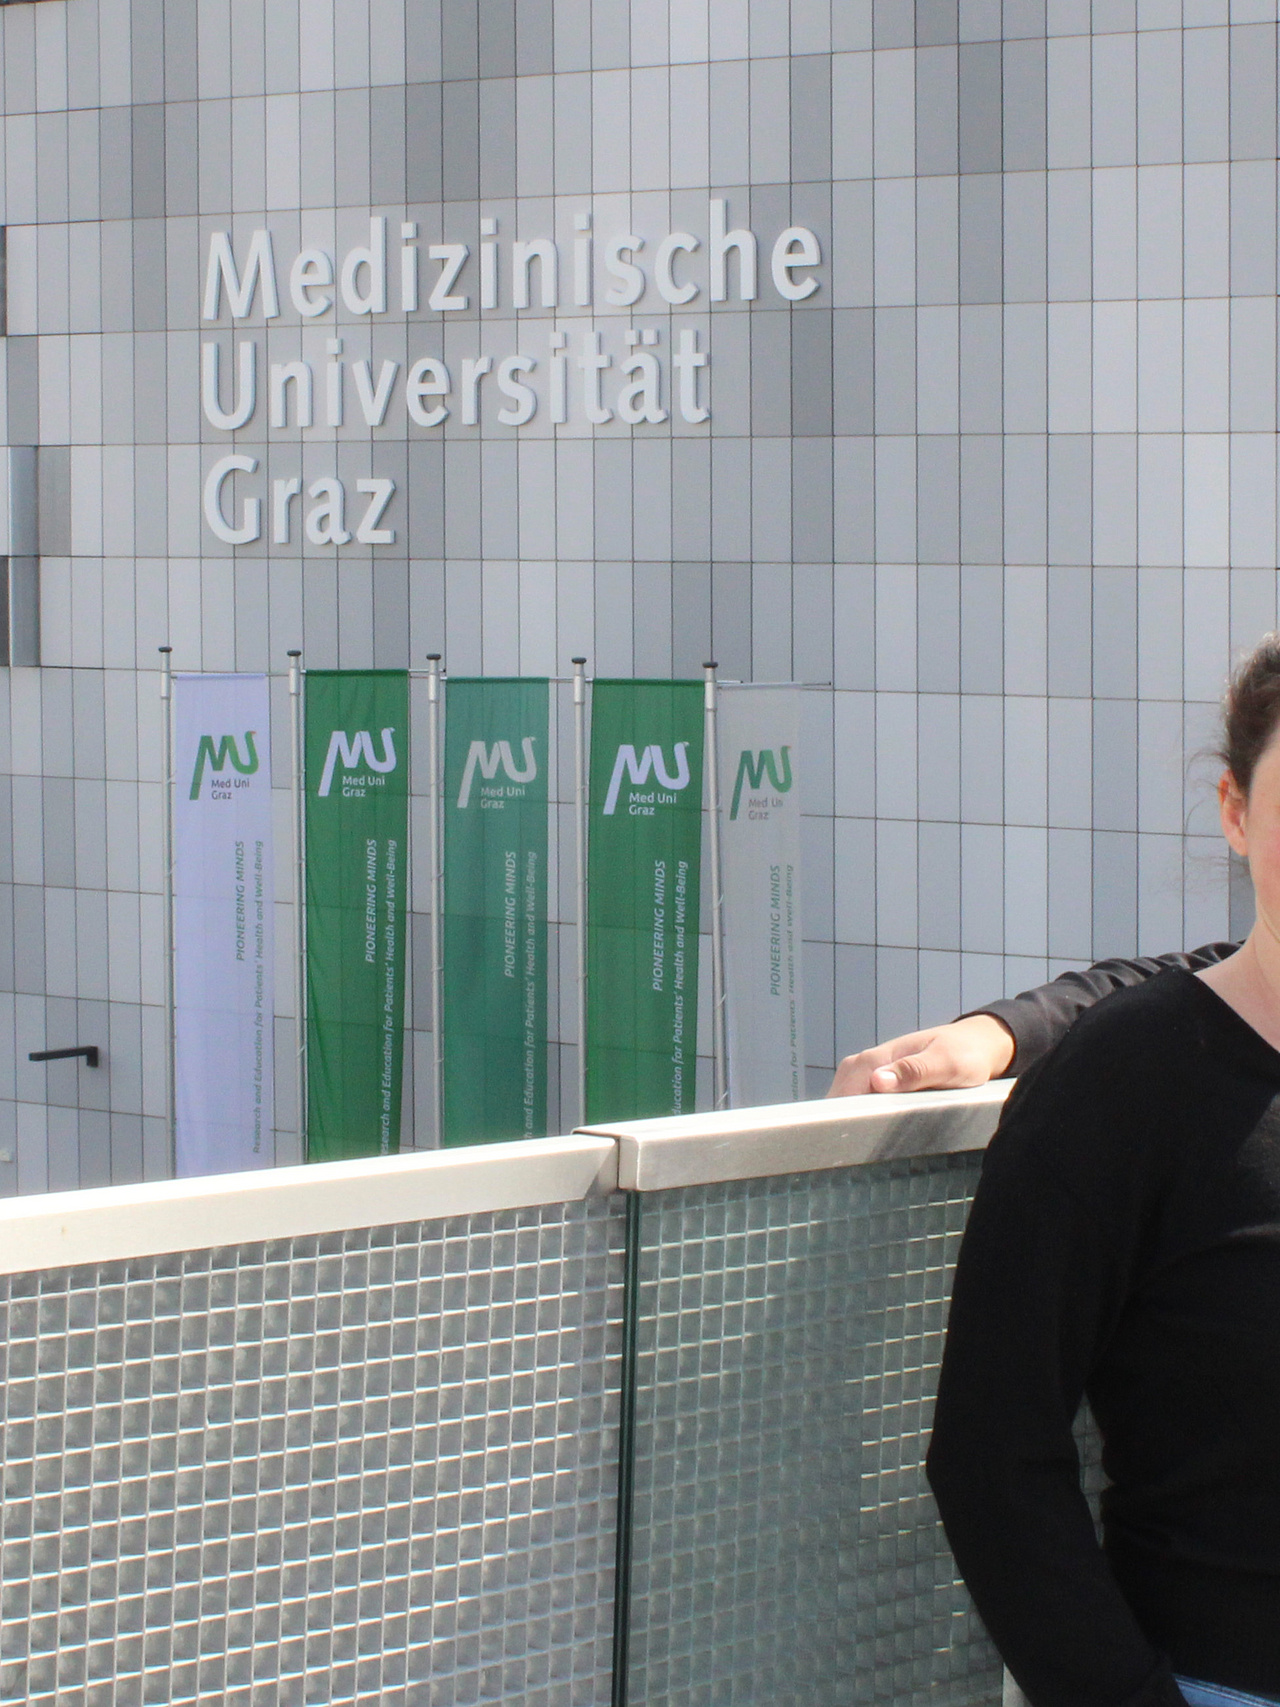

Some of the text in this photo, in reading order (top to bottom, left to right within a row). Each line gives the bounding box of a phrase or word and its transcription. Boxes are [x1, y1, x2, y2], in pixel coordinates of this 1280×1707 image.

[203, 199, 820, 321] Medizinische
[202, 329, 711, 431] Universität
[203, 454, 397, 545] Graz
[211, 779, 250, 788] Med Uni
[211, 790, 232, 800] Graz
[342, 775, 385, 785] Med Uni
[342, 787, 366, 798] Graz
[481, 786, 525, 796] Med Uni
[629, 792, 677, 803] Med Uni
[481, 798, 505, 809] Graz
[629, 804, 655, 816] Graz
[748, 810, 769, 820] Graz
[254, 840, 264, 898] Well-Being
[386, 839, 398, 899] Well-Being
[526, 851, 537, 912] Well-Being
[234, 840, 245, 962] PIONEERING MINDS
[365, 838, 377, 963] PIONEERING MINDS
[675, 860, 688, 923] Well-Being
[255, 901, 263, 921] and
[386, 901, 395, 922] and
[504, 850, 517, 978] PIONEERING MINDS
[526, 914, 535, 936] and
[652, 859, 666, 992] PIONEERING MINDS
[254, 923, 263, 959] Health
[384, 924, 395, 962] Health
[674, 925, 685, 948] and
[770, 864, 781, 996] PIONEERING MINDS
[525, 938, 536, 976] Health
[673, 951, 684, 990] Health
[254, 1011, 264, 1028] for
[382, 1015, 395, 1033] for
[254, 1029, 262, 1082] Education
[524, 1030, 536, 1048] for
[672, 1046, 684, 1065] for
[382, 1033, 393, 1088] Education
[790, 1051, 799, 1068] for
[253, 1084, 262, 1104] and
[524, 1050, 534, 1106] Education
[672, 1066, 683, 1115] ducation
[381, 1090, 392, 1112] and
[524, 1106, 533, 1130] and
[252, 1107, 261, 1154] Research
[380, 1113, 391, 1155] esearch
